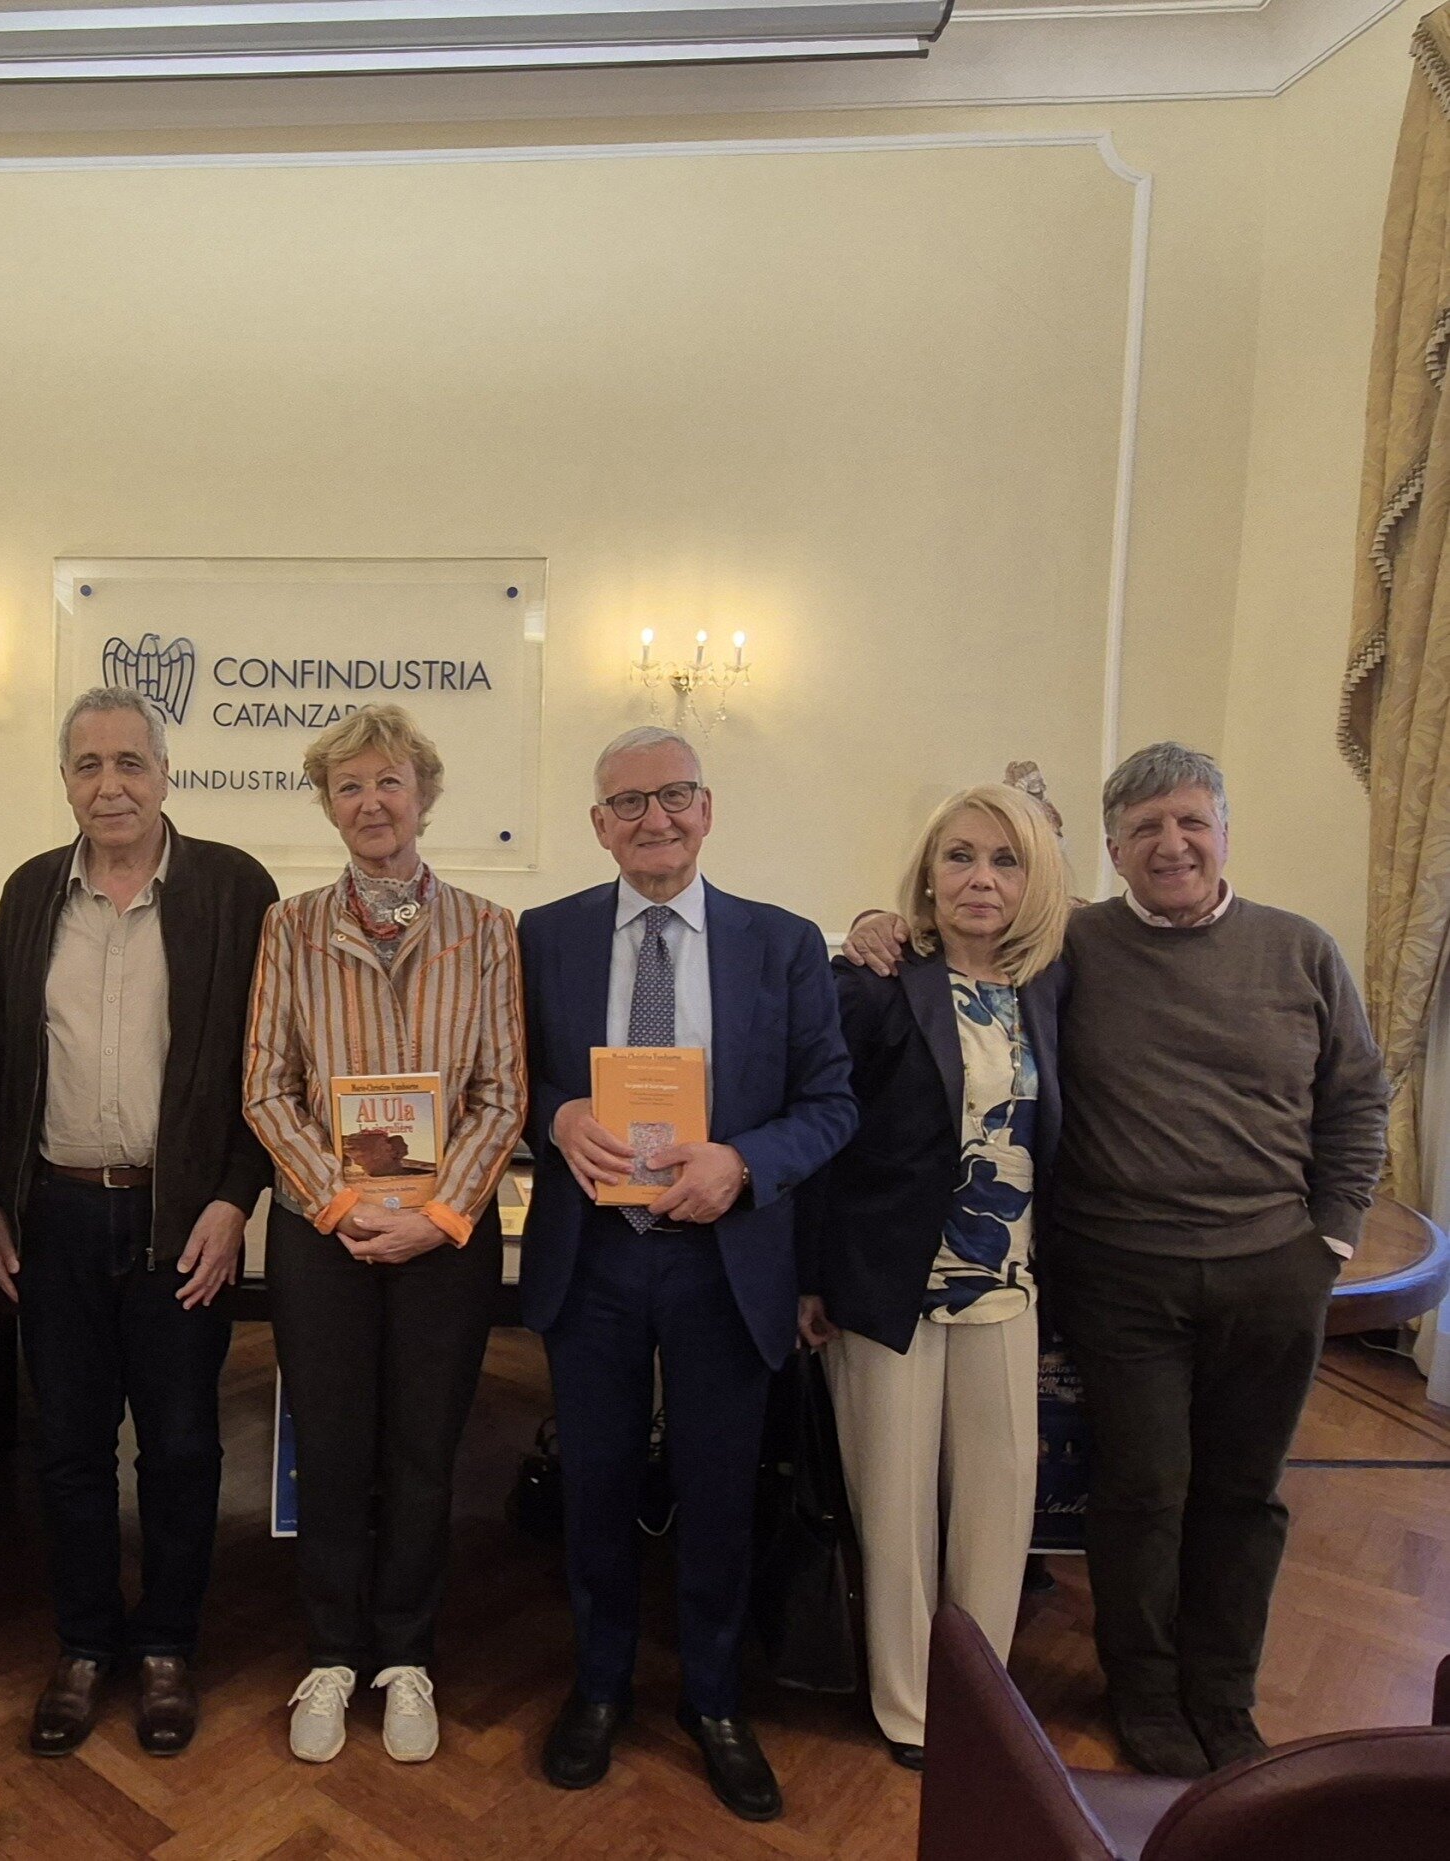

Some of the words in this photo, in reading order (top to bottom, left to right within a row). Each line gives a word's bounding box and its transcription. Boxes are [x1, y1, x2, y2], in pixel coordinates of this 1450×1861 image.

[213, 657, 492, 690] CONFINDUSTRIA
[213, 702, 377, 728] CATANZA
[167, 769, 313, 791] NINDUSTRIA
[356, 1098, 377, 1123] Al
[380, 1097, 415, 1122] Ula
